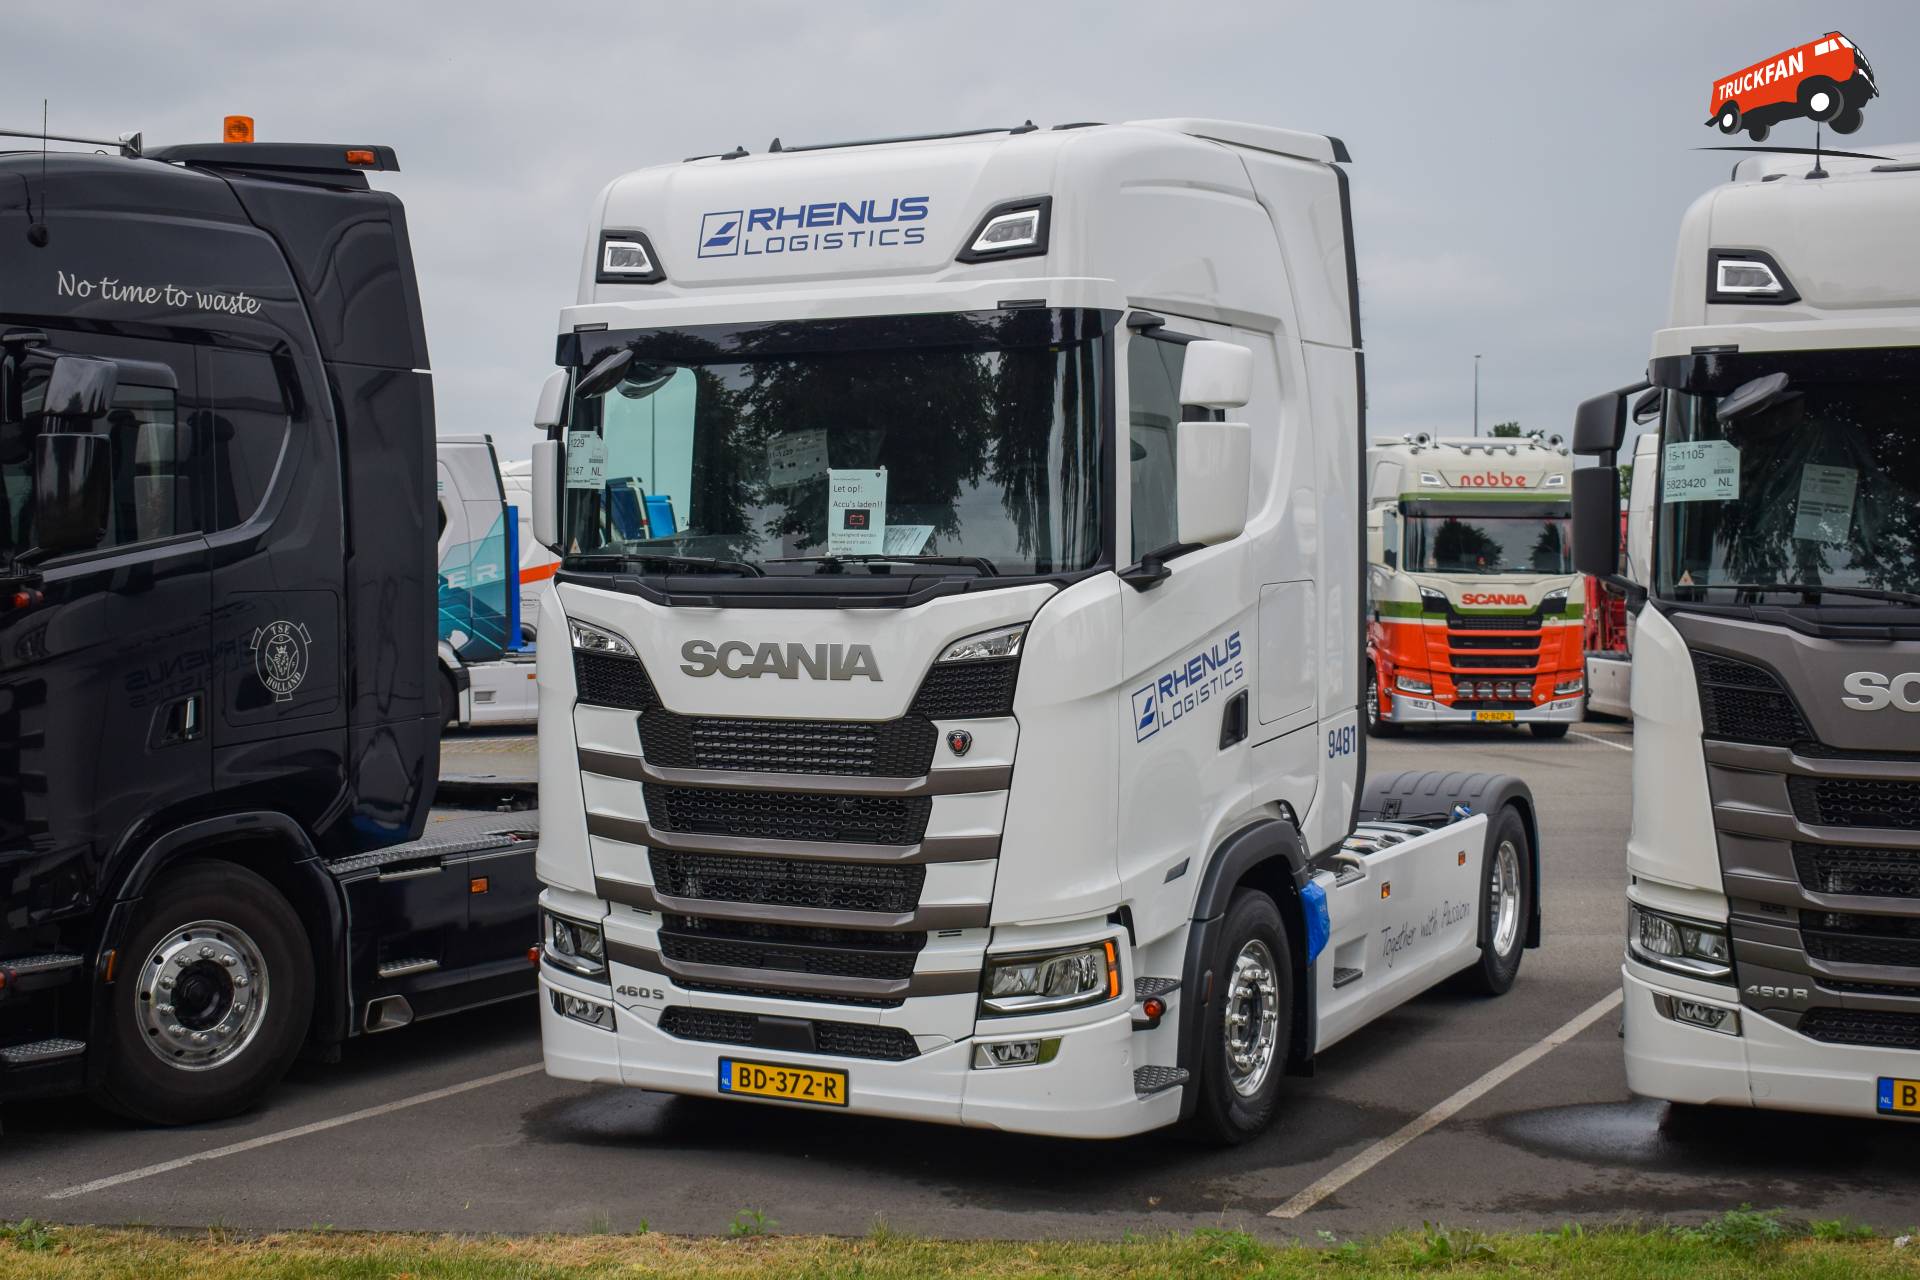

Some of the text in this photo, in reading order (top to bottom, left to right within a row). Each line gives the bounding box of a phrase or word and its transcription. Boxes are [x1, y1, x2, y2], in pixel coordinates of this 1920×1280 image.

[746, 196, 930, 233] RHENUS
[744, 226, 926, 256] LOGISTICS
[57, 270, 262, 315] No time to waste
[591, 466, 603, 477] NL
[1460, 471, 1526, 488] nobbe
[833, 484, 846, 493] Let
[1718, 477, 1733, 487] NL
[832, 500, 856, 508] Accu's
[438, 563, 499, 589] ER
[1461, 592, 1528, 606] SCANIA
[270, 624, 291, 635] TSE
[679, 639, 884, 682] SCANIA
[1157, 630, 1242, 704] RHENUS
[265, 671, 302, 692] HOLLAND
[1161, 661, 1244, 728] LOGISTICS
[1328, 725, 1356, 759] 9481
[1381, 920, 1417, 969] Together
[1420, 906, 1438, 937] with
[616, 984, 665, 1000] 460 S
[1792, 988, 1808, 1000] R
[721, 1076, 731, 1086] NL
[739, 1066, 837, 1099] BD-372-R
[1880, 1095, 1892, 1104] NL
